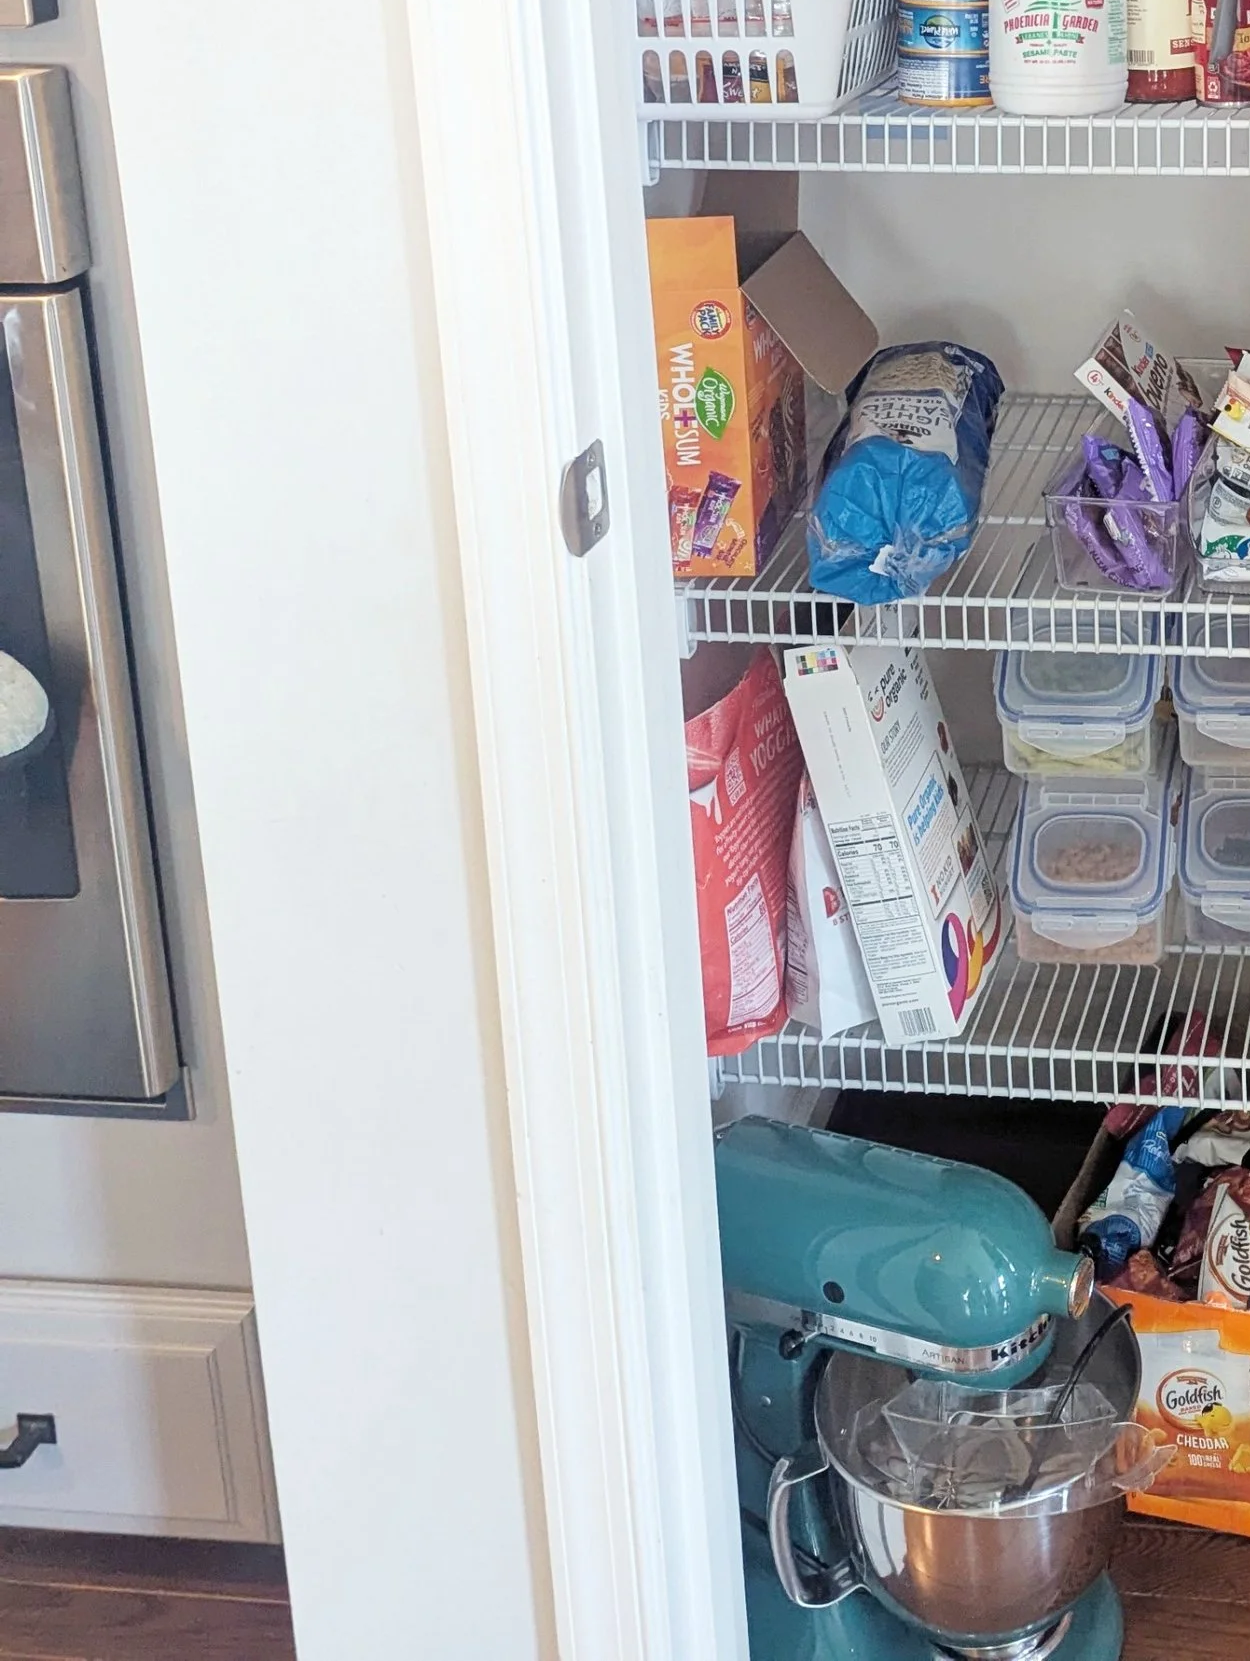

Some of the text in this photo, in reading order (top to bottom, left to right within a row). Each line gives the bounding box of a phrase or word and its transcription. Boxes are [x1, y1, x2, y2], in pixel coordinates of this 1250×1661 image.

[1004, 13, 1099, 33] PHOENICIA GARDEN
[1053, 49, 1078, 58] PASTE
[697, 306, 711, 337] PACK
[706, 303, 721, 336] FAMILY
[1137, 352, 1169, 410] bueno
[696, 376, 719, 428] Organic
[879, 663, 896, 691] pure
[884, 668, 908, 709] organic
[906, 773, 938, 831] Pure Organic
[831, 826, 848, 835] Nutrition
[837, 841, 899, 857] Calories 70 70
[922, 1348, 965, 1365] ARTISAN
[1165, 1384, 1223, 1411] Goldfish
[1176, 1434, 1230, 1450] CHEDDAR
